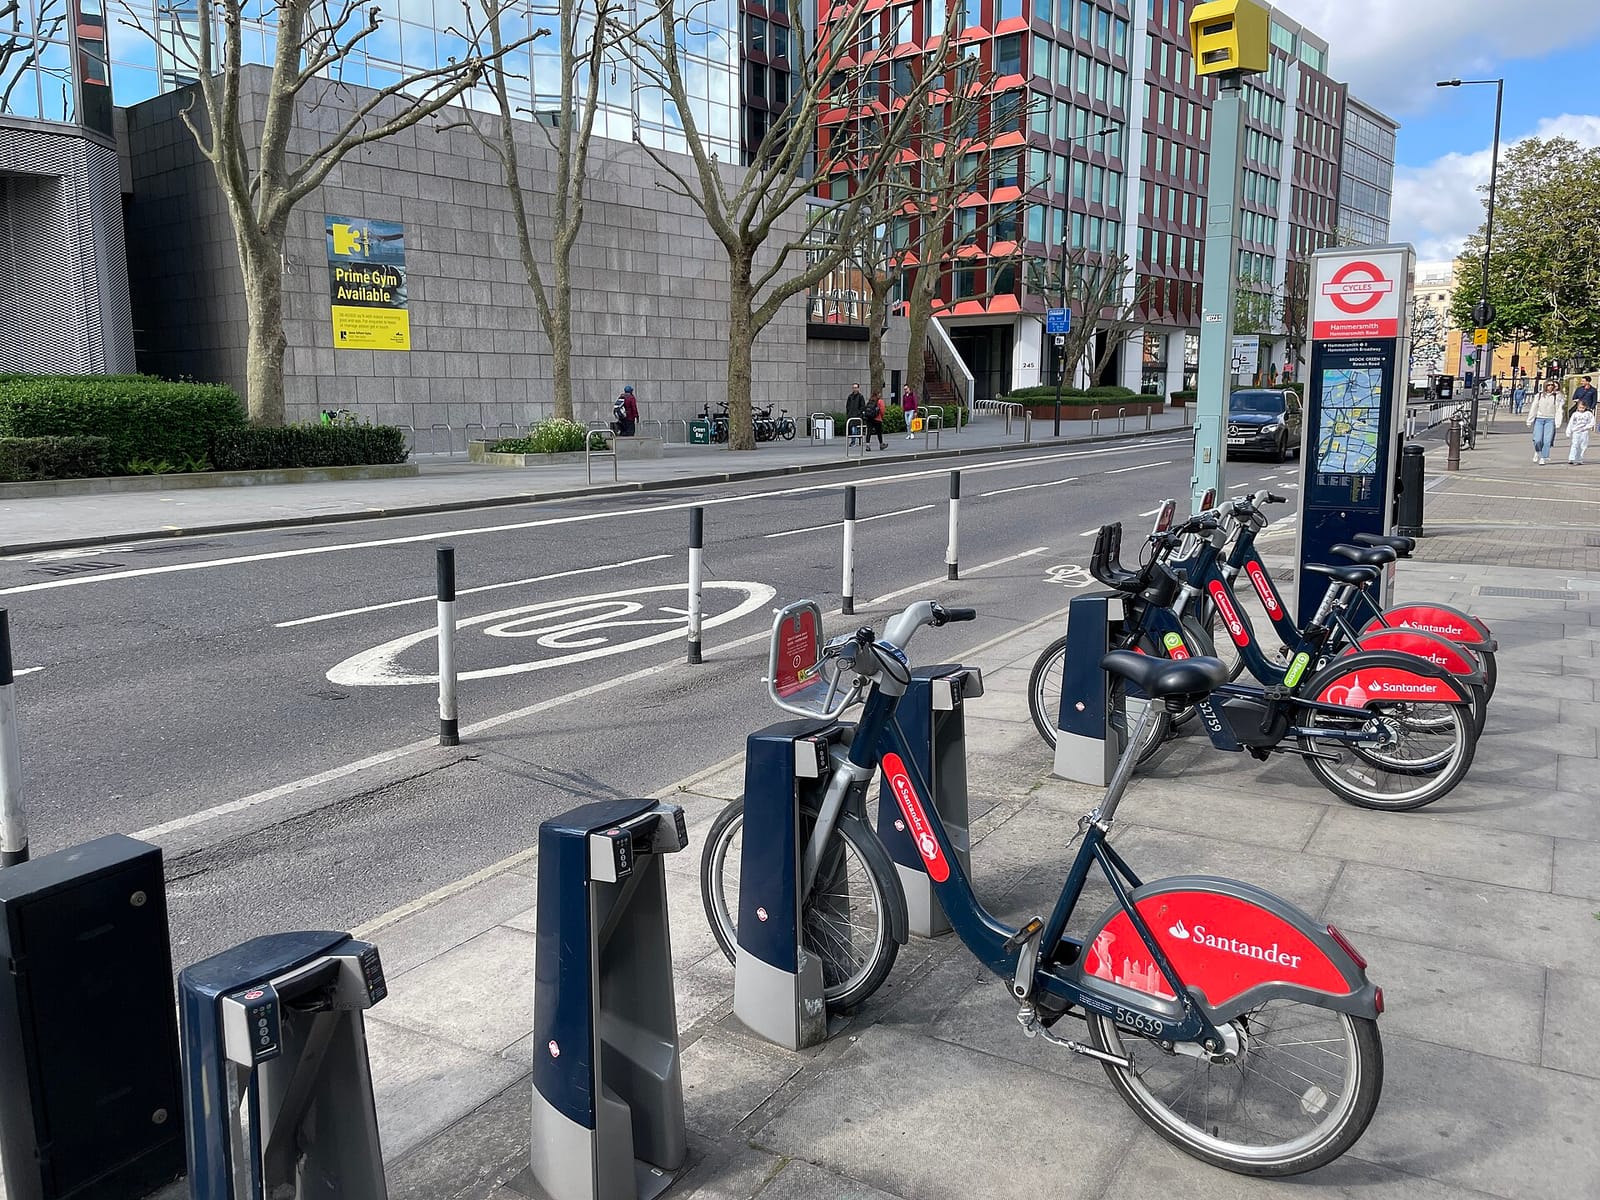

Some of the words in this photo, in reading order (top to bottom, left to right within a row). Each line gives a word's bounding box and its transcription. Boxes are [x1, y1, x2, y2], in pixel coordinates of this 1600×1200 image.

[335, 268, 370, 284] Prime
[372, 271, 397, 288] Gym
[337, 286, 391, 302] Available
[1342, 284, 1372, 292] CYCLES
[1330, 323, 1379, 331] Hammersmith
[1411, 621, 1463, 635] Santander
[1382, 682, 1437, 693] Santander
[901, 788, 923, 831] Santander
[1192, 925, 1301, 969] Santander
[1115, 1007, 1163, 1035] 56639
